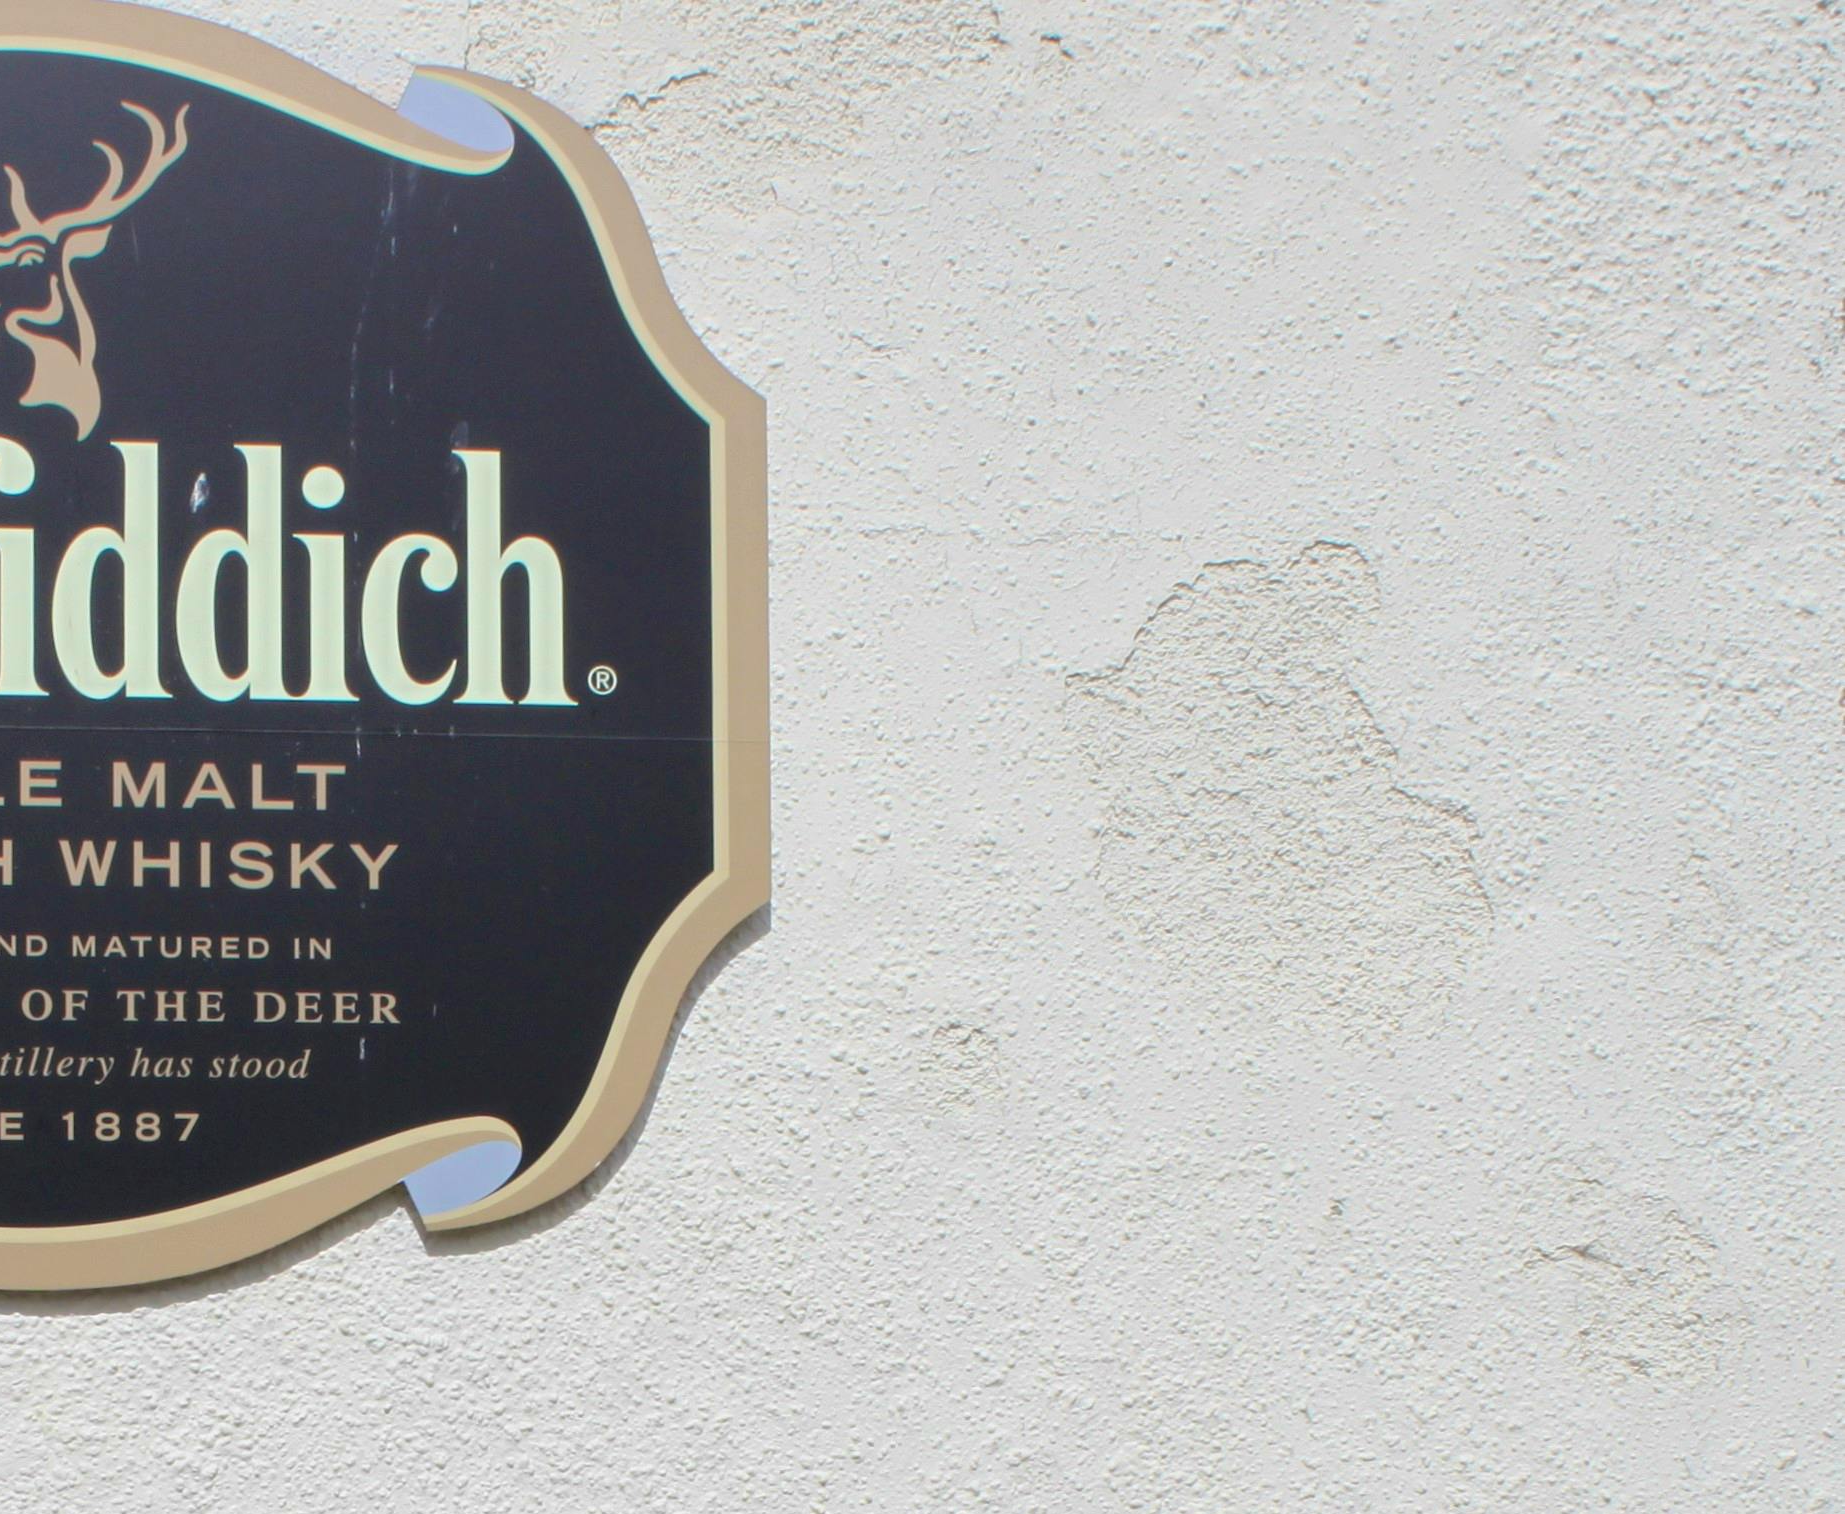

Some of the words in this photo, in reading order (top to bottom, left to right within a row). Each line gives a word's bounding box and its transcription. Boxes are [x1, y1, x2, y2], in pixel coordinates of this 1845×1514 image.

[112, 761, 347, 811] MALT
[58, 839, 399, 890] WHISKY
[72, 935, 270, 959] MATURED
[294, 937, 332, 960] IN
[21, 989, 89, 1021] OF
[116, 990, 226, 1022] THE
[254, 991, 400, 1024] DEER
[130, 1047, 193, 1078] has
[209, 1048, 311, 1079] stood
[62, 1111, 200, 1142] 1887
